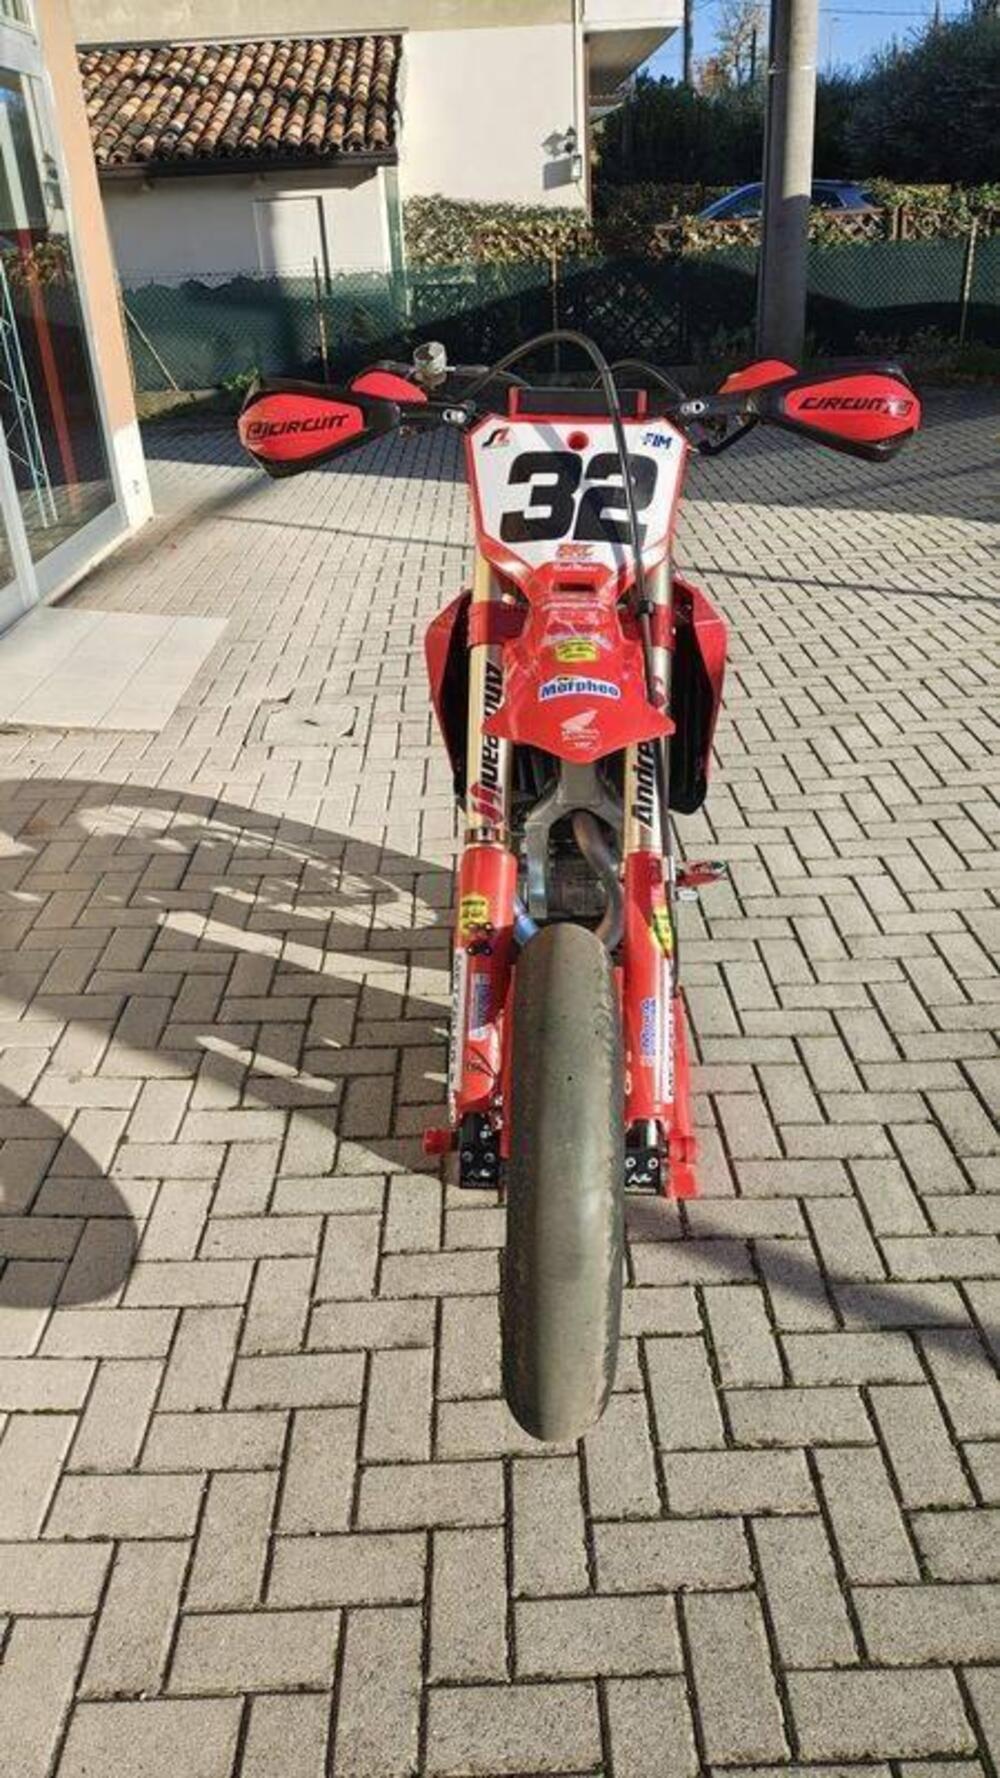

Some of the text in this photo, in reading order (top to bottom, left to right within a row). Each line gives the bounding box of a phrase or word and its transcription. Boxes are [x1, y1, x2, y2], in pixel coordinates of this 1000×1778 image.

[798, 397, 887, 411] CIRCUIT
[499, 451, 659, 545] 32
[631, 741, 655, 829] Andre
